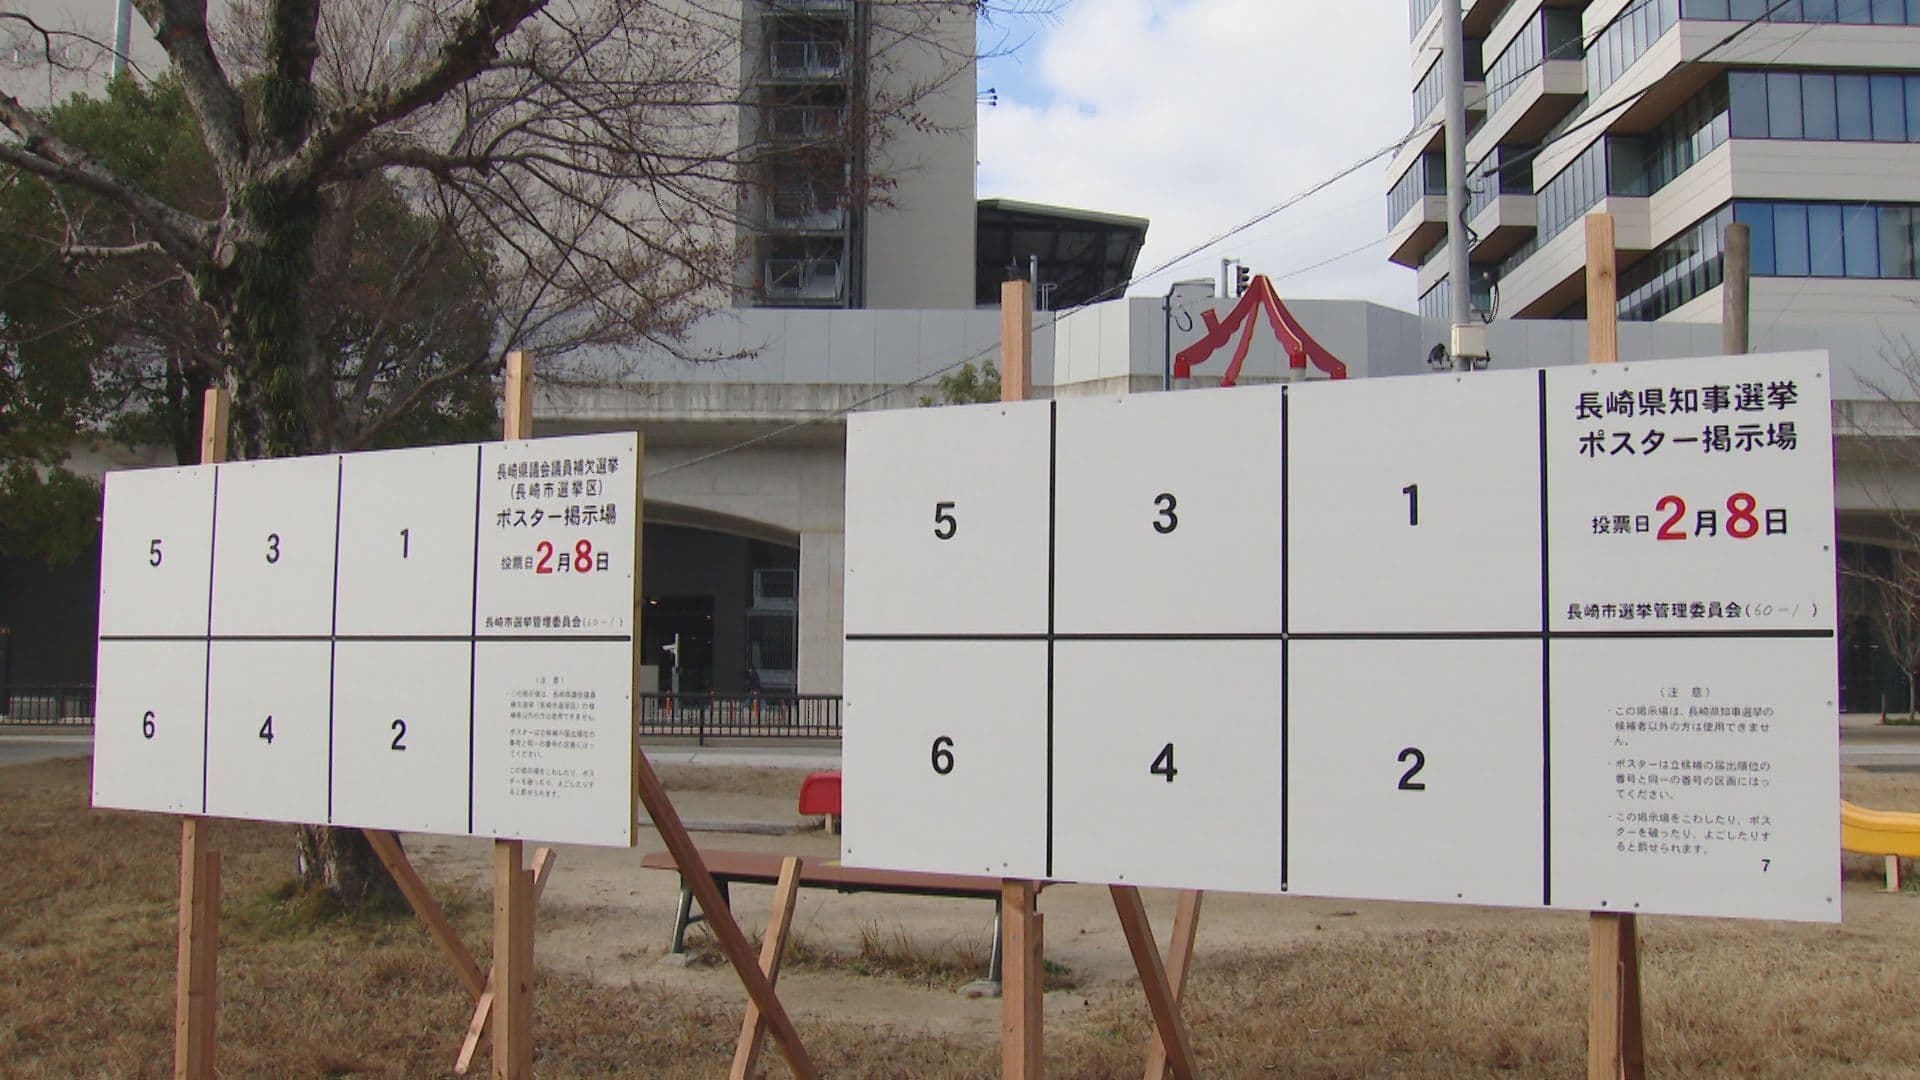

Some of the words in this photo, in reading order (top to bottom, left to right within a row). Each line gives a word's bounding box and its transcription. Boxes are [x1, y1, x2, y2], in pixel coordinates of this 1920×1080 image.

[1575, 380, 1798, 420] 長崎県知事選挙
[1579, 421, 1797, 458] ポスター掲示場
[497, 457, 618, 480] 長崎県議会議員補欠選挙
[497, 503, 616, 527] ポスター掲示場
[934, 502, 957, 540] 5
[1153, 493, 1178, 534] 3
[1403, 484, 1418, 526] 1
[1592, 492, 1787, 541] 投票日2月8日
[150, 539, 162, 567] 5
[266, 533, 280, 564] 3
[400, 528, 408, 559] 1
[501, 539, 608, 574] 投票日2月8日
[143, 711, 155, 739] 6
[259, 715, 274, 744] 4
[391, 719, 406, 751] 2
[932, 736, 954, 775] 6
[1150, 743, 1178, 783] 4
[1397, 747, 1425, 791] 2
[1761, 859, 1771, 872] 7
